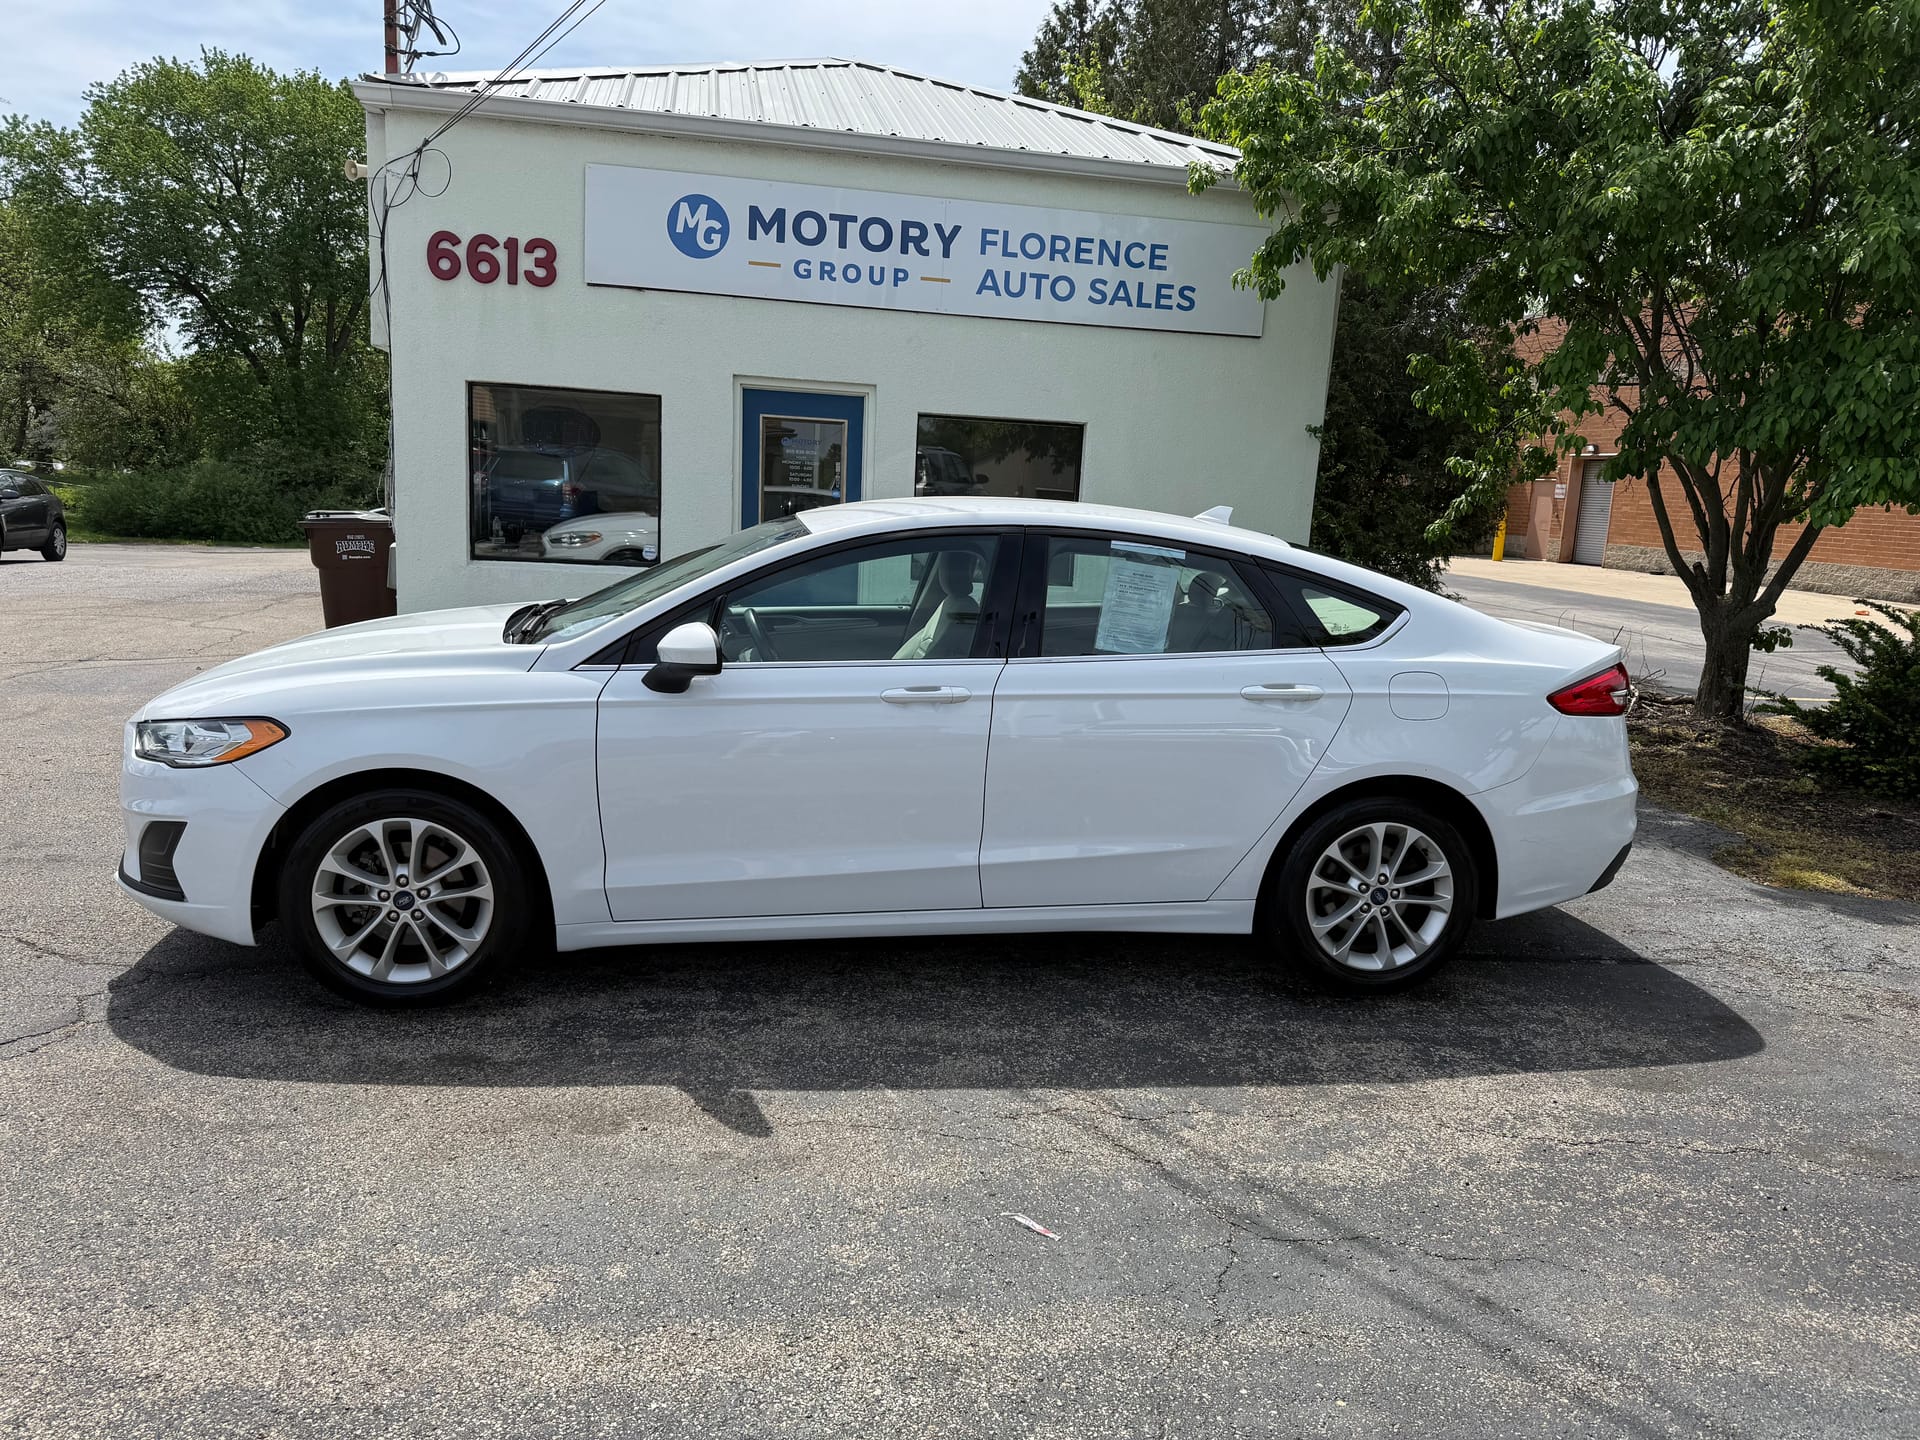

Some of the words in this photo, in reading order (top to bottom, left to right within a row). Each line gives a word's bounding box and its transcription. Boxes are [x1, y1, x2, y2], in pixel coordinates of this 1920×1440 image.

[748, 205, 962, 259] MOTORY
[980, 228, 1169, 271] FLORENCE
[427, 230, 557, 287] 6613
[793, 258, 909, 288] GROUP
[976, 269, 1076, 302] AUTO
[1088, 278, 1197, 312] SALES
